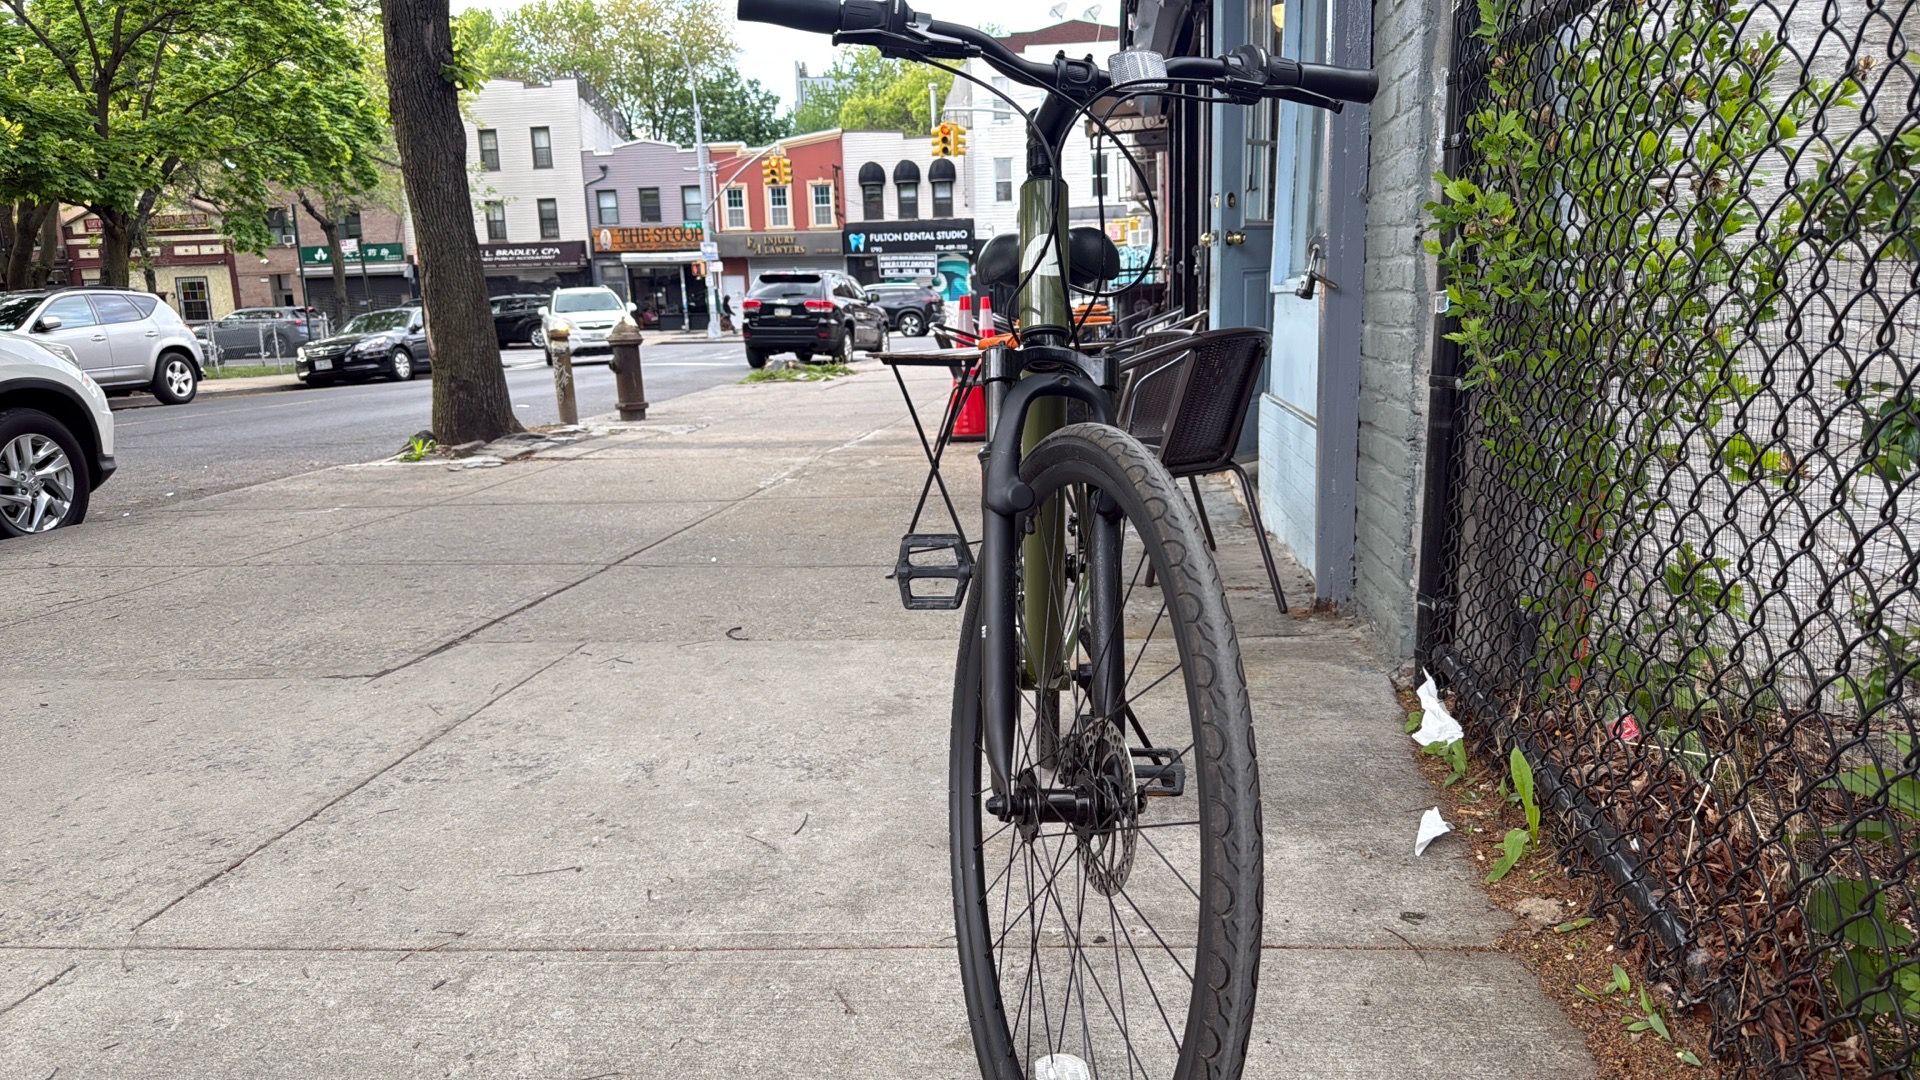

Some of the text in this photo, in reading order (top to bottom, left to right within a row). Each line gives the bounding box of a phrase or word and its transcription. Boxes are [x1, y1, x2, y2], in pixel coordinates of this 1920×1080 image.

[618, 229, 651, 243] THE
[763, 235, 796, 246] INJURY
[870, 230, 968, 242] FULTON DENTAL STUDIO
[495, 248, 539, 256] BRADLEY,
[541, 247, 560, 255] CPA
[764, 245, 807, 255] LAWYERS
